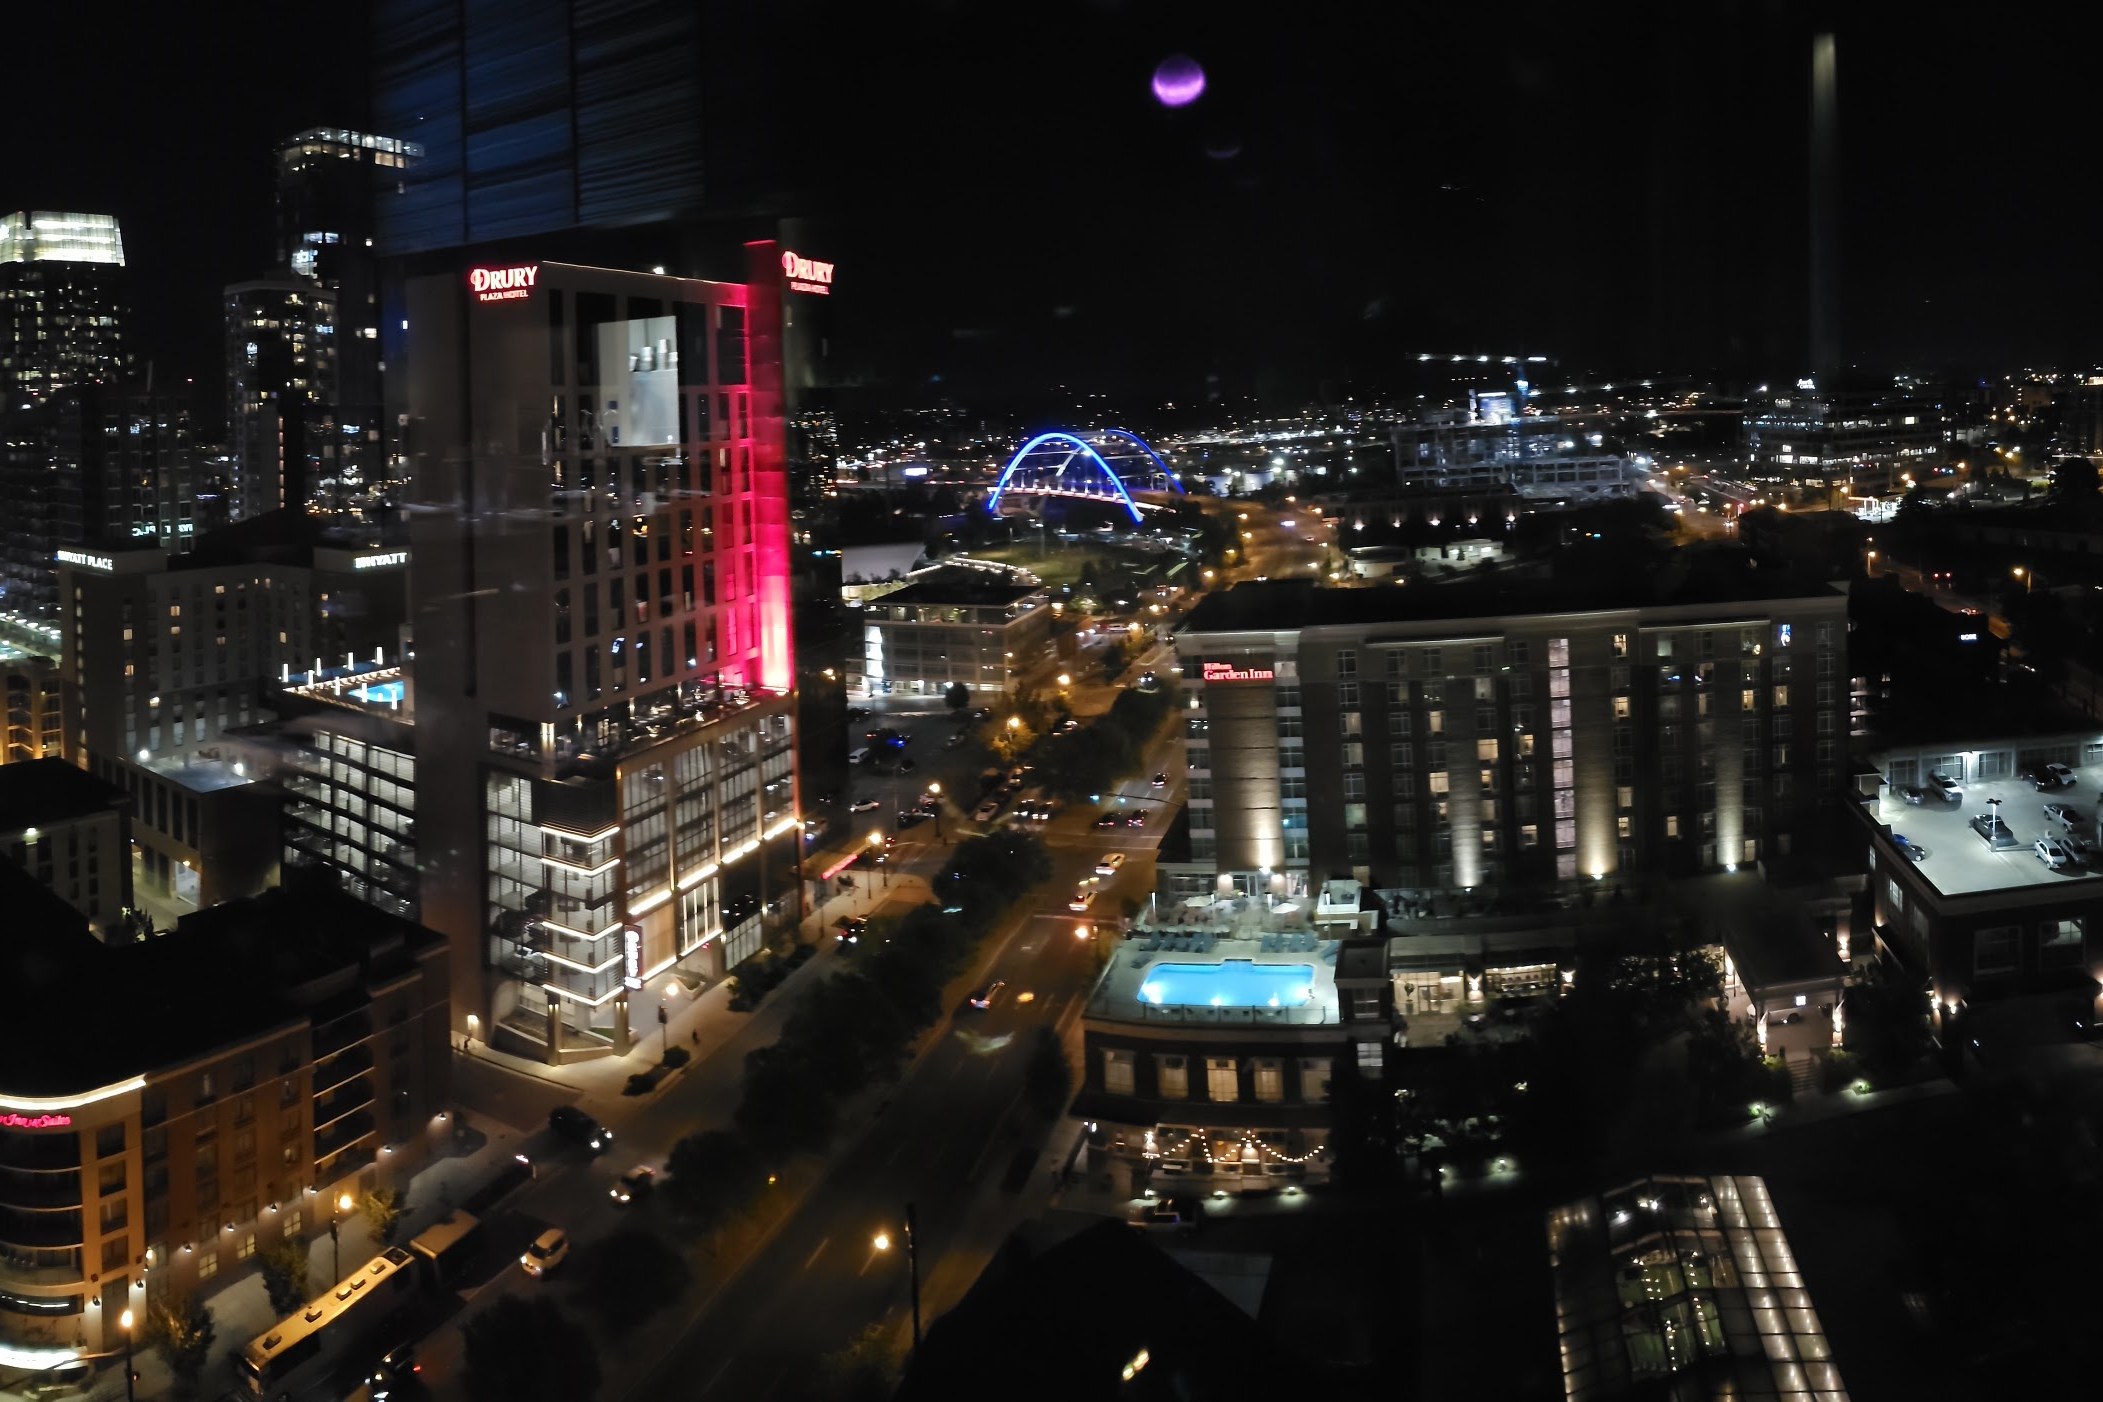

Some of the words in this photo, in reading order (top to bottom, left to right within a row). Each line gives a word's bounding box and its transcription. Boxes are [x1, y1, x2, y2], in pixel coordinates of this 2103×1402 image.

[782, 250, 834, 283] DRURY
[470, 265, 538, 292] DRURY
[480, 292, 503, 301] PLAZA
[503, 289, 528, 299] HOTEL
[87, 555, 113, 570] PLACE
[366, 552, 408, 566] HYATT
[1203, 669, 1249, 680] Garden
[1249, 668, 1273, 679] Inn
